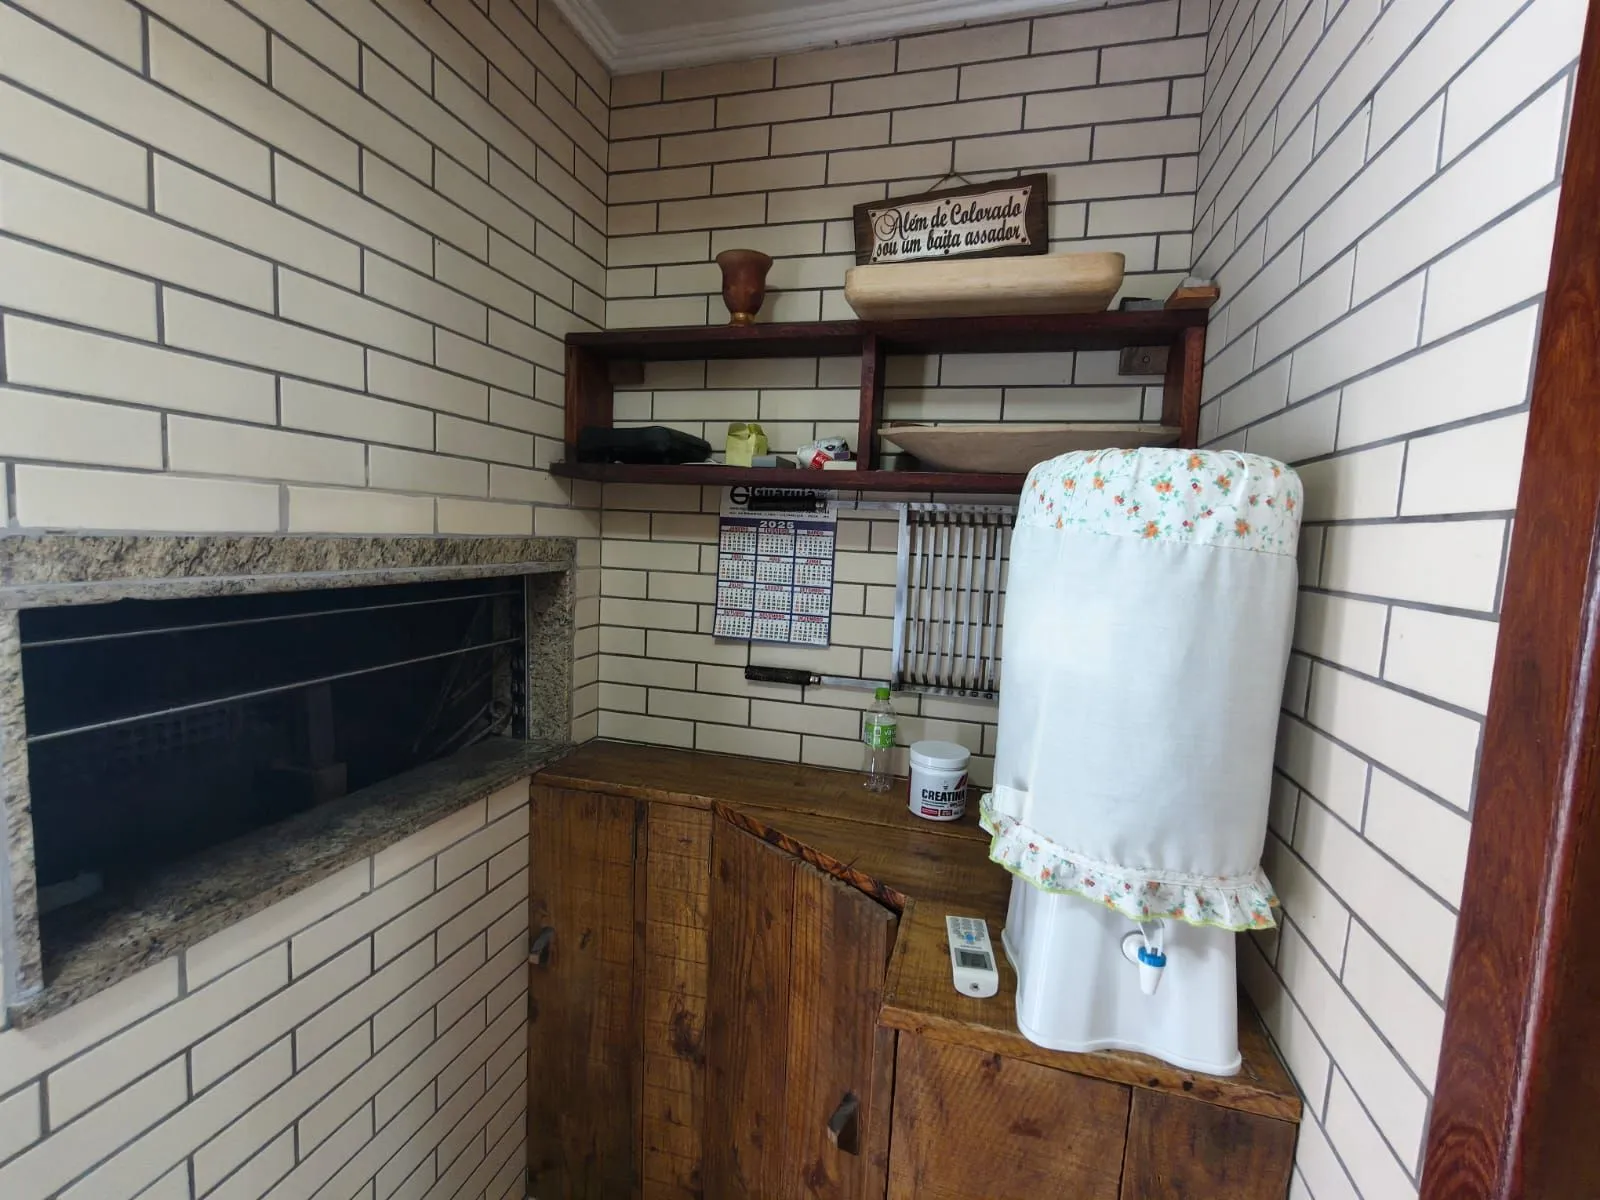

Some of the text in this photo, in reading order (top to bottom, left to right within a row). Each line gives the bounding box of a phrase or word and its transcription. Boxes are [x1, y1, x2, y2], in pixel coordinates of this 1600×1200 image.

[874, 196, 1023, 242] Além de Colorado
[876, 219, 1021, 257] sou um baita assador
[759, 520, 794, 529] 2025
